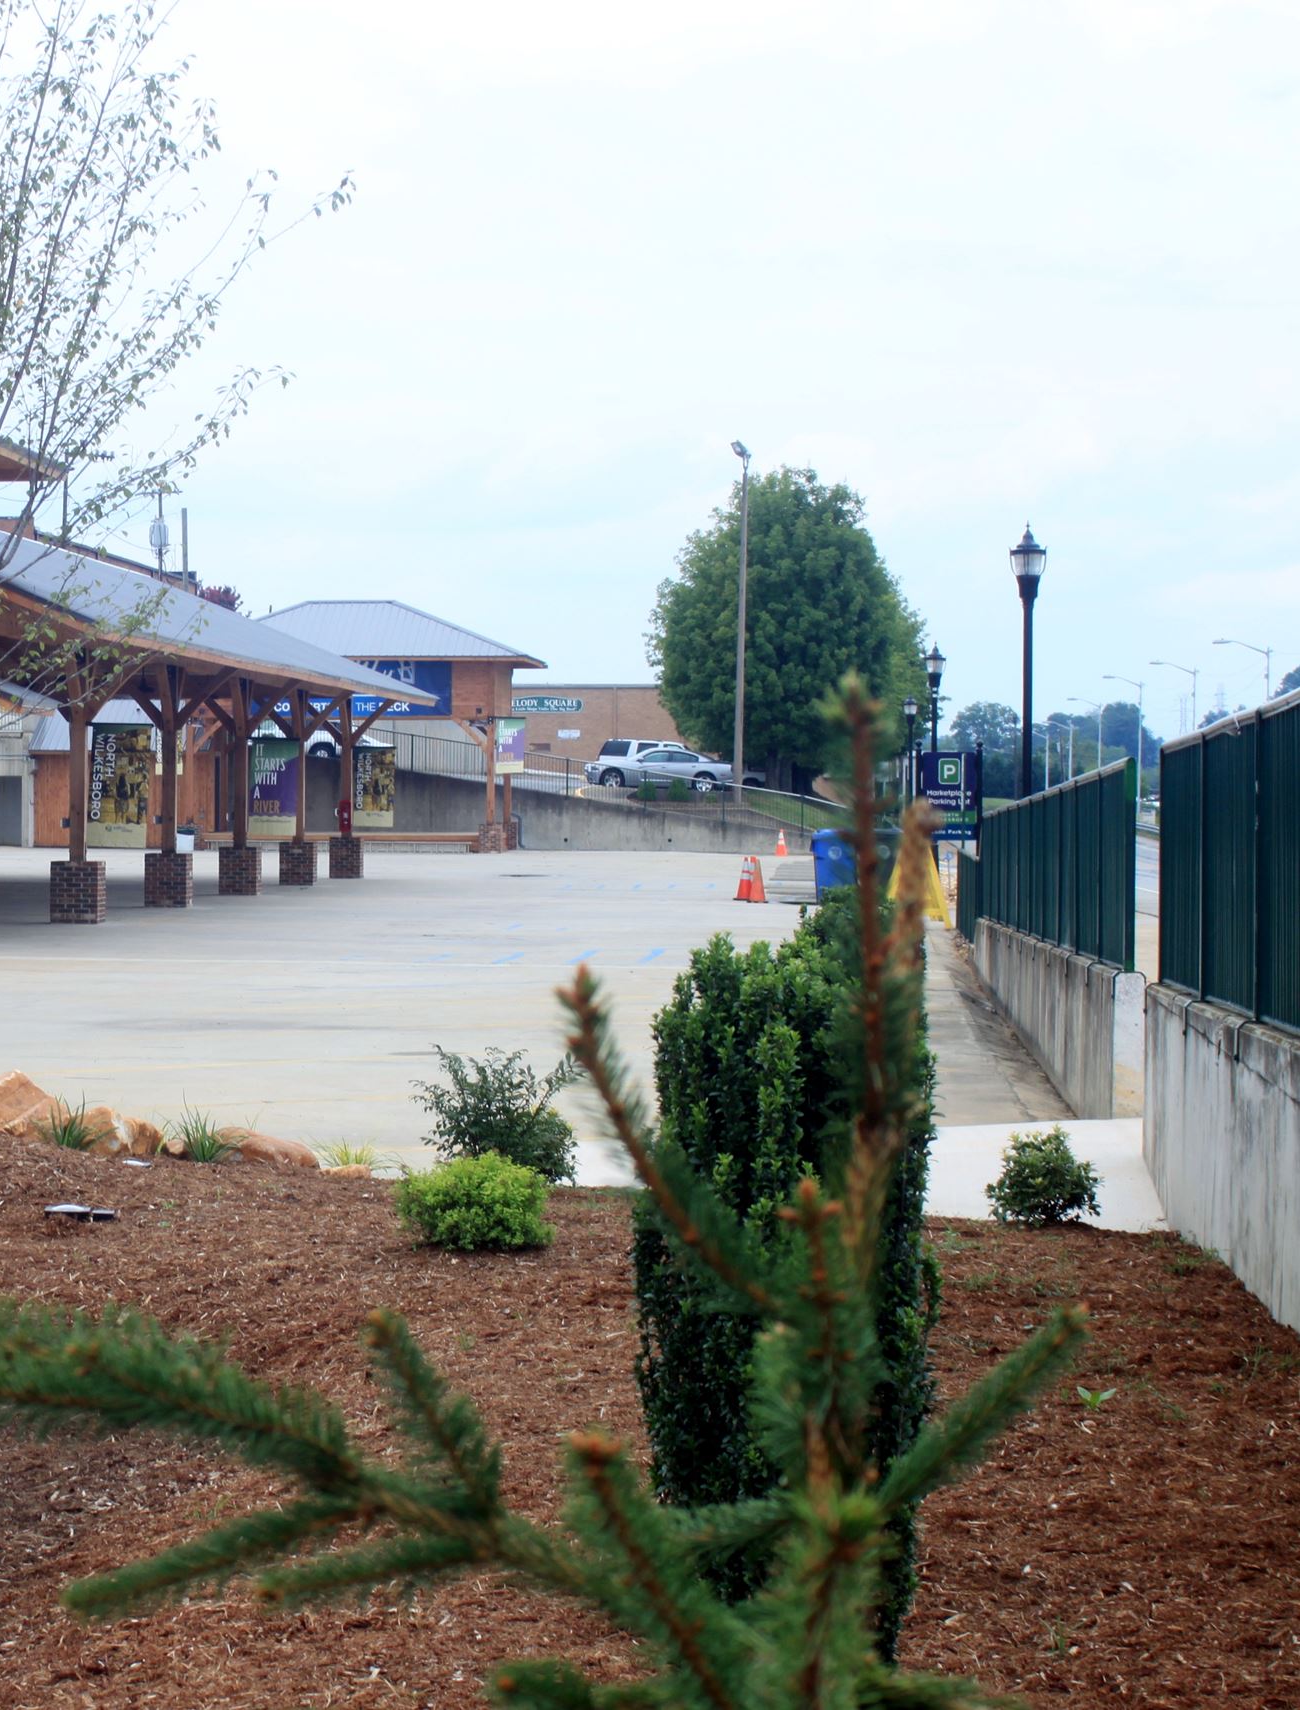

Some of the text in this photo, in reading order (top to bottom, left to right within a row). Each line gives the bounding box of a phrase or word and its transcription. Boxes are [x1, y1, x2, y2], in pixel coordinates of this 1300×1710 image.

[356, 702, 376, 712] THE
[378, 701, 410, 712] ECK
[511, 699, 578, 707] ELODY SQUARE
[105, 733, 116, 777] NORTH
[256, 744, 264, 756] IT
[254, 758, 286, 771] STARTS
[91, 733, 106, 819] WILKESBORO
[943, 764, 956, 779] P
[254, 772, 277, 785] WITH
[253, 786, 260, 799] A
[253, 800, 280, 813] RIVER
[928, 798, 956, 806] Parking
